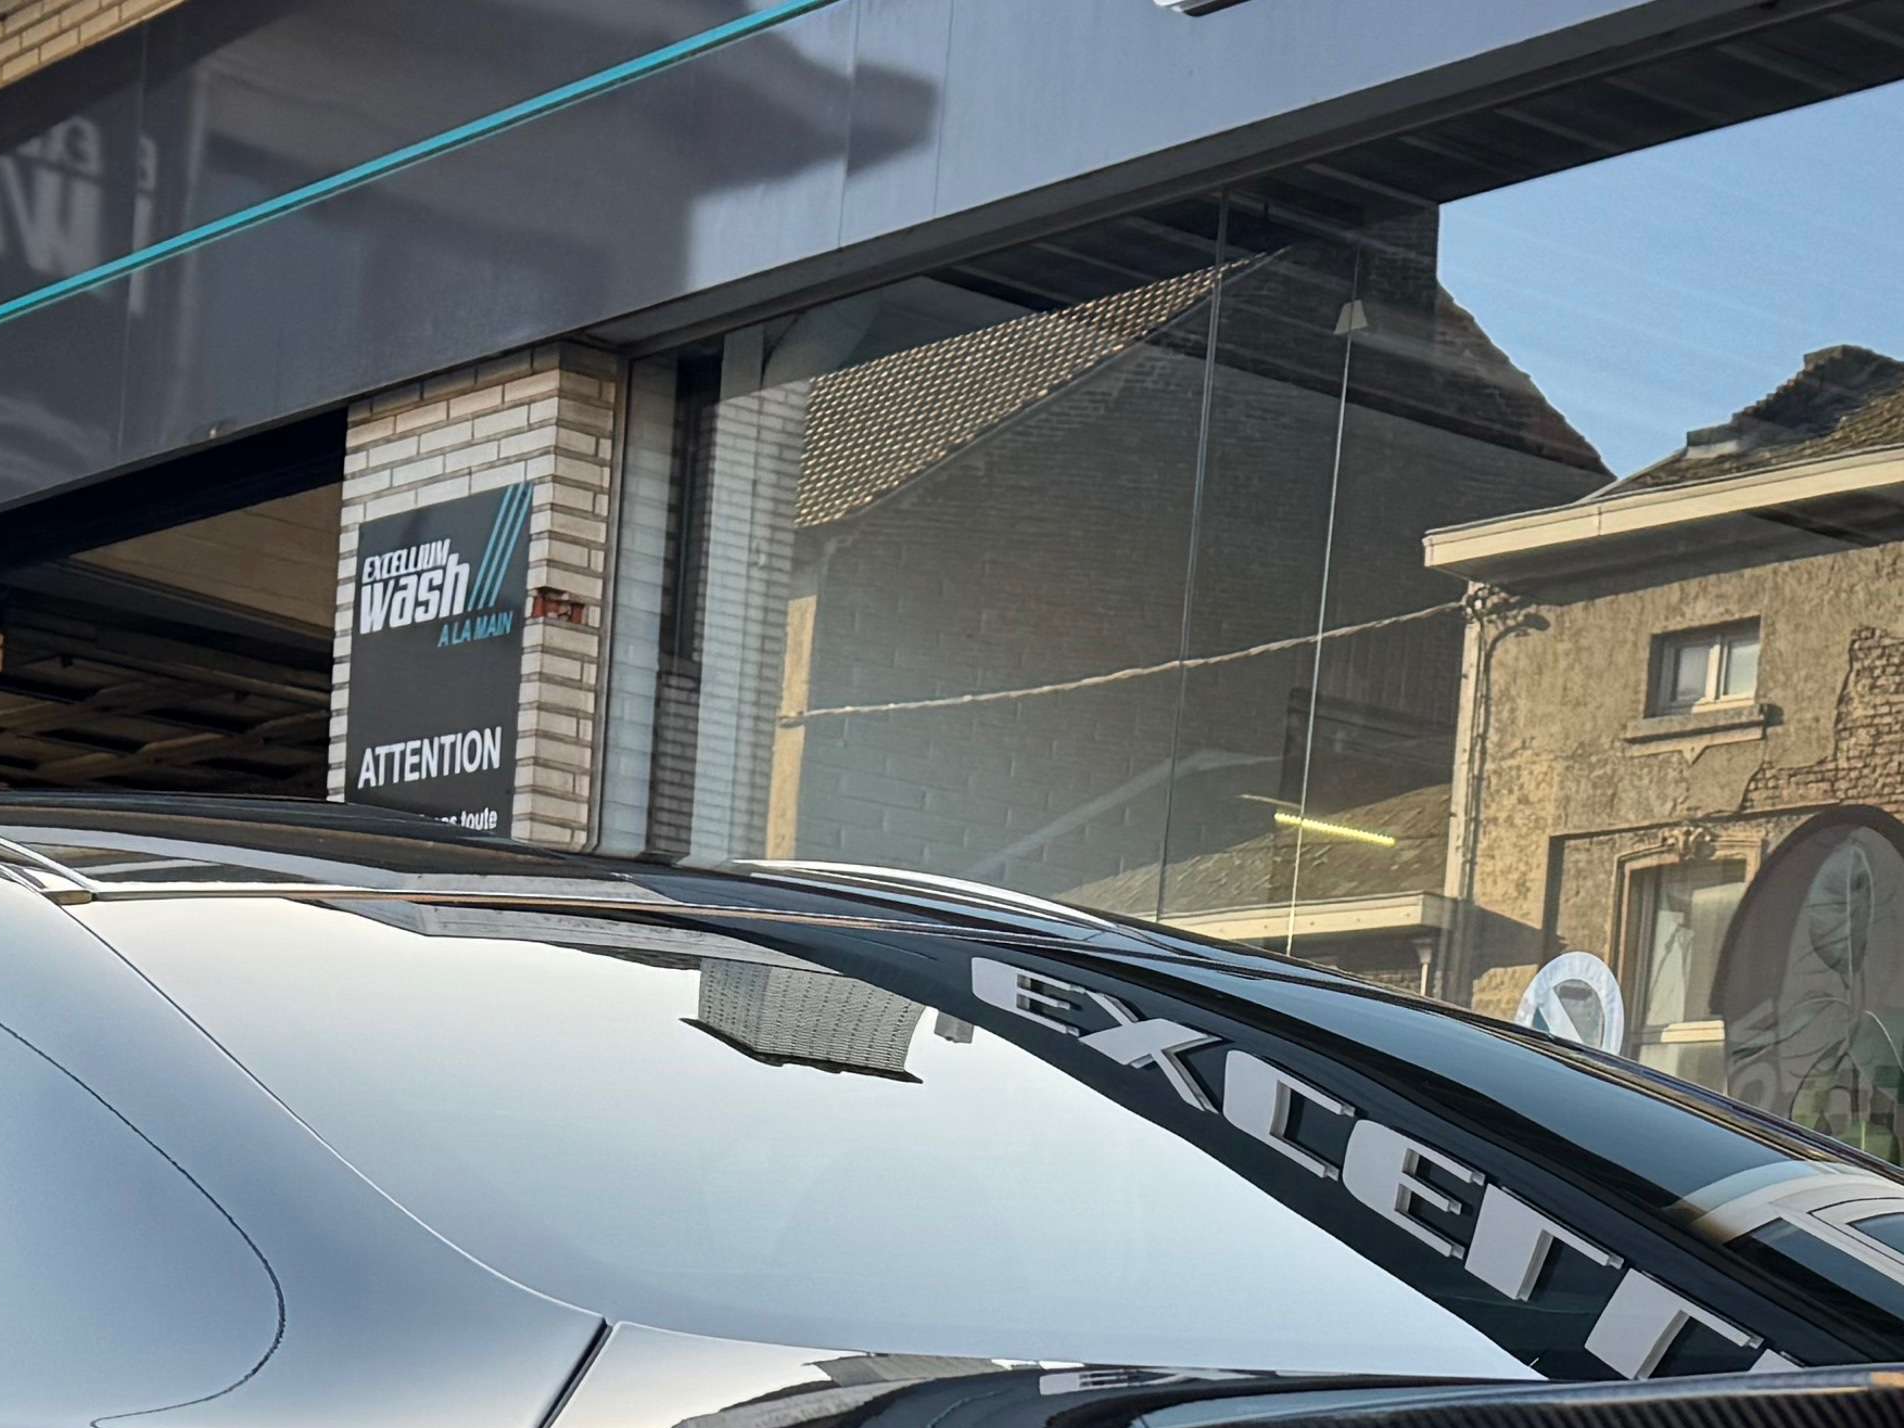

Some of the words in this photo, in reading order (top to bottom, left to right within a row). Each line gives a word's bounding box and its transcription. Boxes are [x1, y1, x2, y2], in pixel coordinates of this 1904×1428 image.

[362, 538, 451, 584] EXCELLIUM
[360, 553, 470, 635] wash
[437, 624, 449, 648] A
[452, 618, 471, 645] LA
[473, 611, 513, 641] MAIN
[357, 725, 502, 789] ATTENTION
